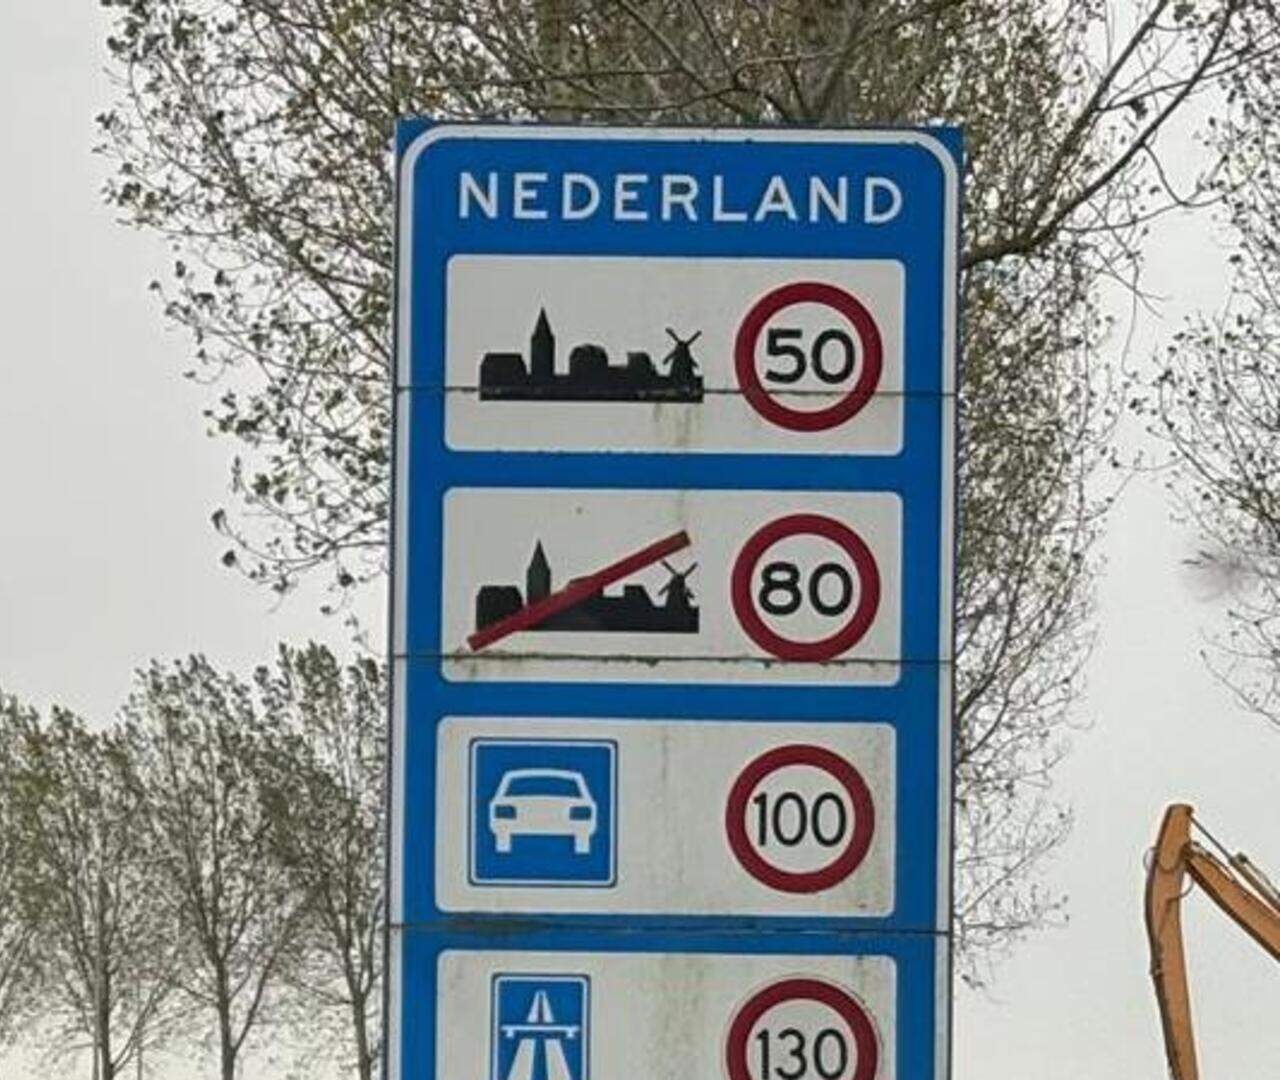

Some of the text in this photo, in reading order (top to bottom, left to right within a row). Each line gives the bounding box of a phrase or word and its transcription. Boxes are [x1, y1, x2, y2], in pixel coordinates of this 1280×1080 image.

[458, 171, 904, 225] NEDERLAND
[764, 327, 857, 384] 50
[759, 560, 853, 618] 80
[752, 790, 847, 848] 100
